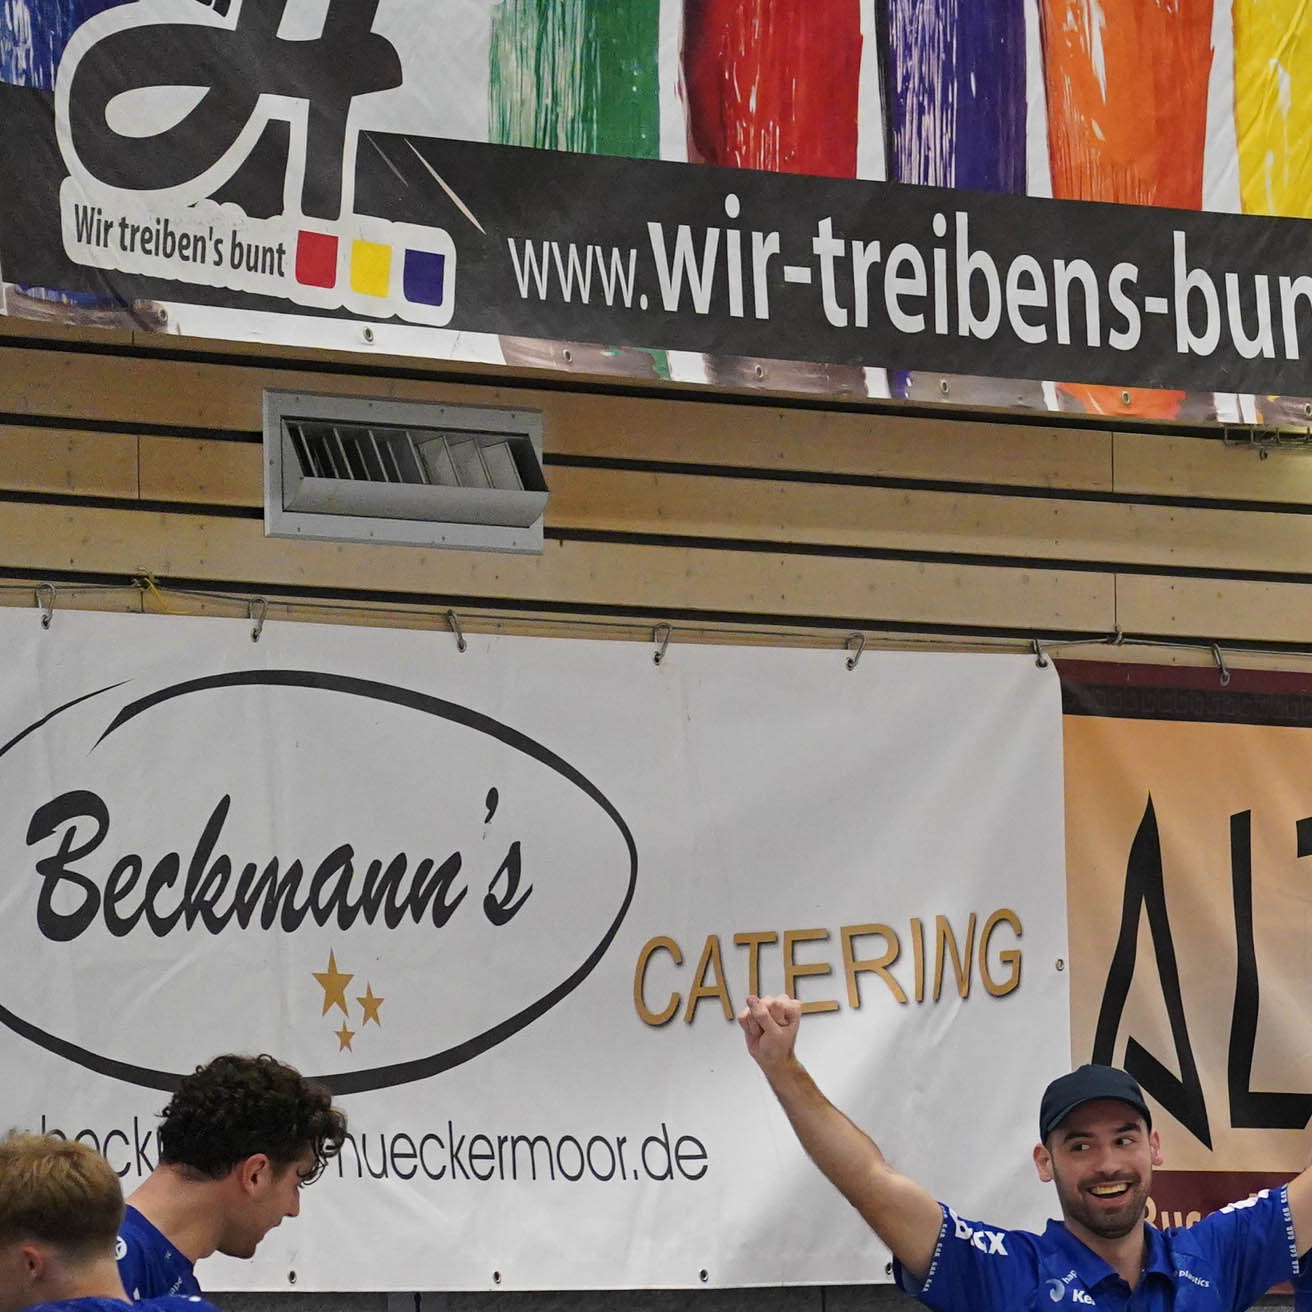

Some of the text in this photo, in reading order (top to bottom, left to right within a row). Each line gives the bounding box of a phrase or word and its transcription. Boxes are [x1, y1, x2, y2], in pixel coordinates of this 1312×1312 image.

[74, 203, 286, 278] Wir treiben's bunt
[26, 786, 533, 942] Beckmann's
[633, 908, 1024, 1027] CATERING
